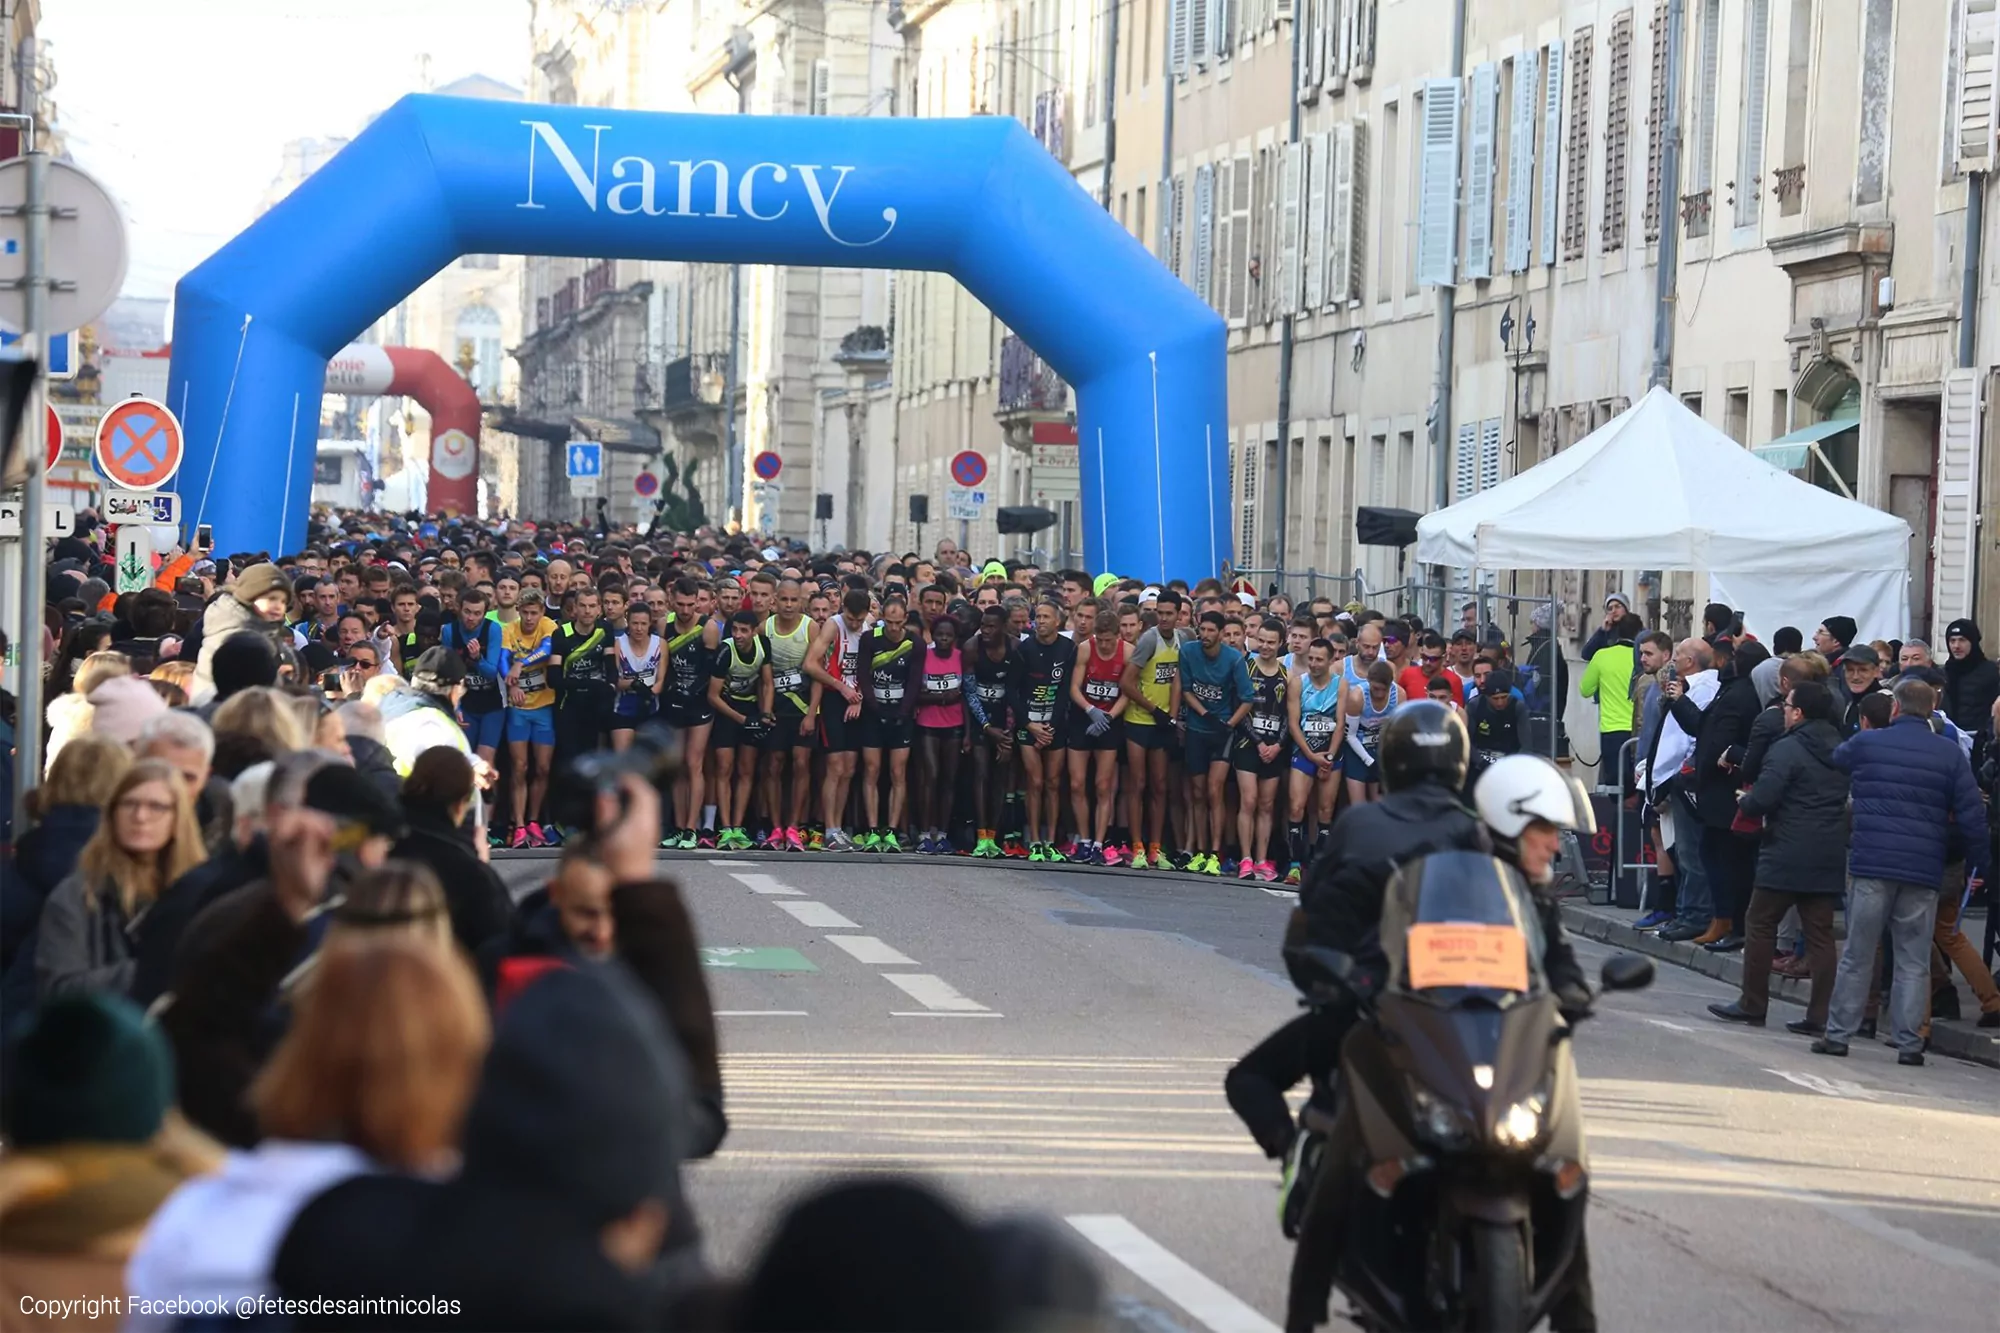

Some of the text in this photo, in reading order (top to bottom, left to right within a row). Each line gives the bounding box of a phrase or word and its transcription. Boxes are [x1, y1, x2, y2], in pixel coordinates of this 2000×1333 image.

[515, 119, 898, 248] Nancy
[779, 676, 792, 686] 42
[936, 680, 949, 689] 19
[884, 689, 891, 698] 8
[984, 689, 996, 697] 12
[1092, 686, 1113, 696] 197
[1261, 719, 1273, 729] 14
[1311, 722, 1330, 731] 106
